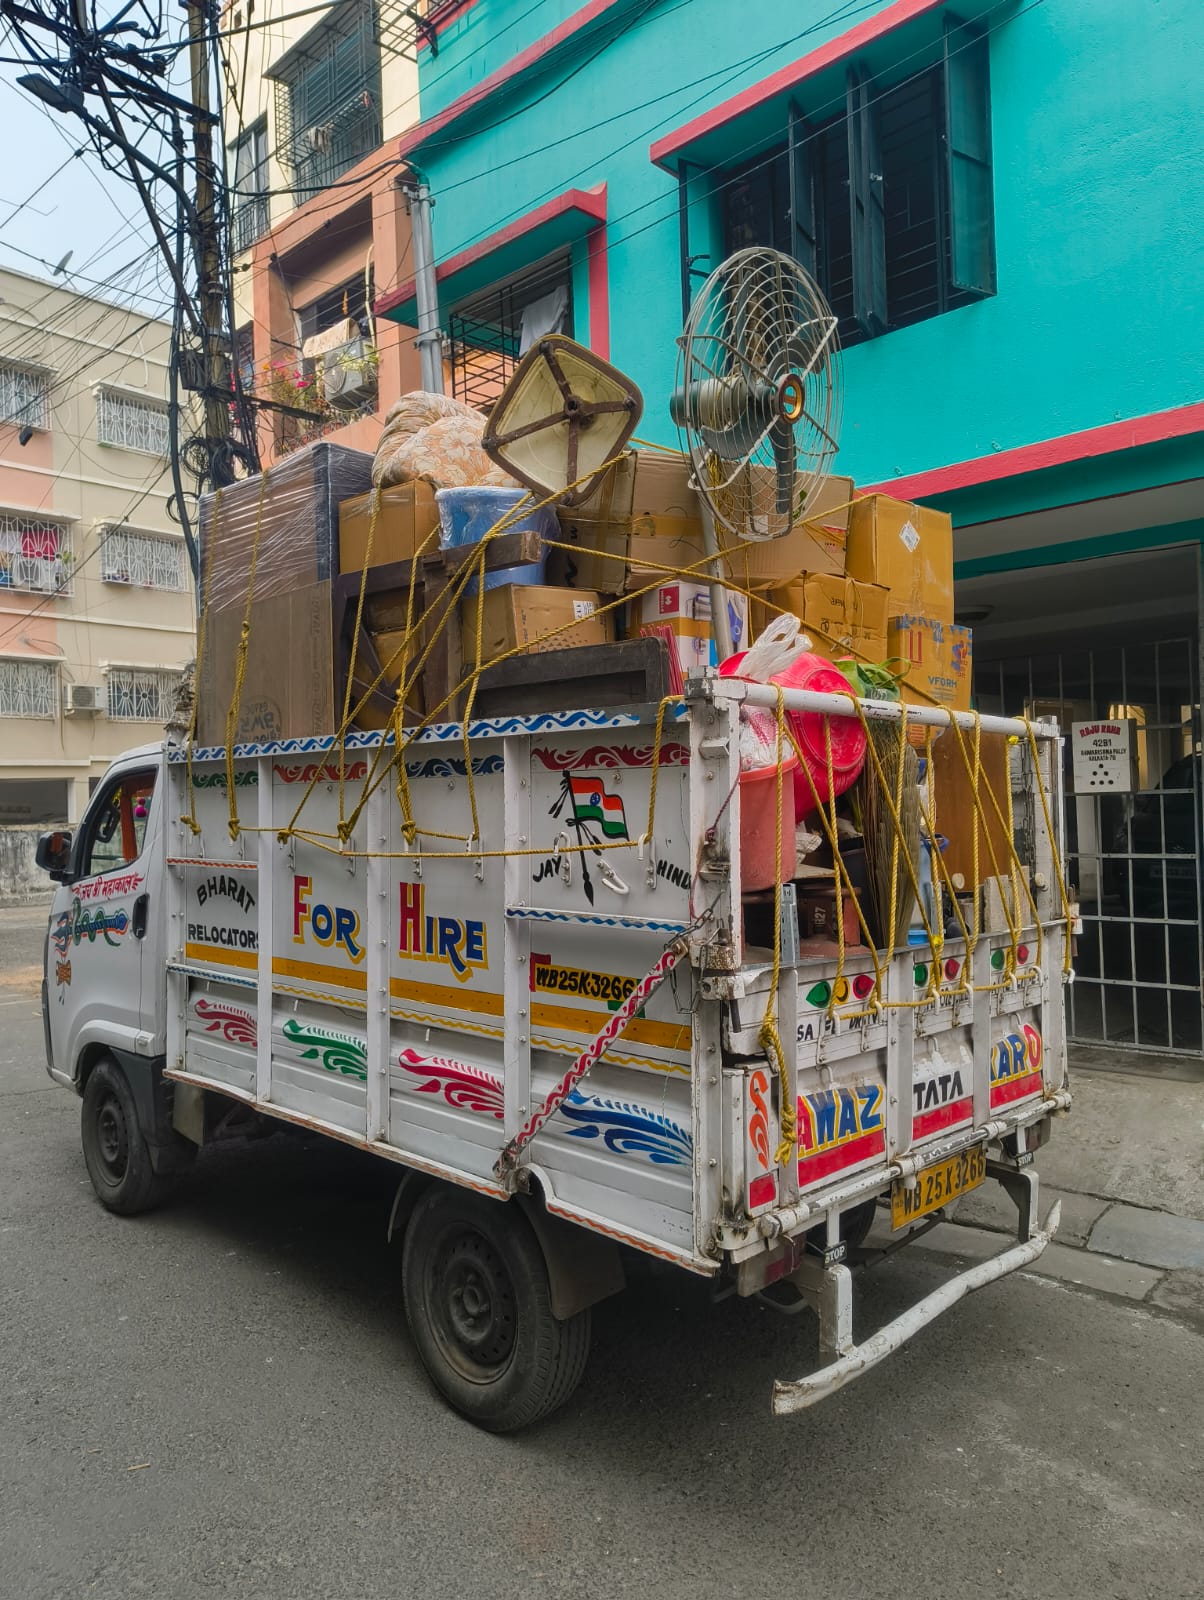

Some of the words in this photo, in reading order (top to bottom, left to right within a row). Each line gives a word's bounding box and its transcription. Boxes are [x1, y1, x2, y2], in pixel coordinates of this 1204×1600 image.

[533, 855, 562, 882] JAY
[196, 874, 255, 914] BHARAT
[188, 923, 259, 950] RELOCATOR
[293, 875, 366, 965] FOR
[399, 882, 489, 984] HIRE
[991, 1023, 1042, 1088] ARO
[913, 1071, 963, 1111] TATA
[925, 1171, 943, 1206] 25
[945, 1165, 954, 1196] K
[955, 1152, 985, 1191] 3266
[824, 1244, 847, 1265] STOP
